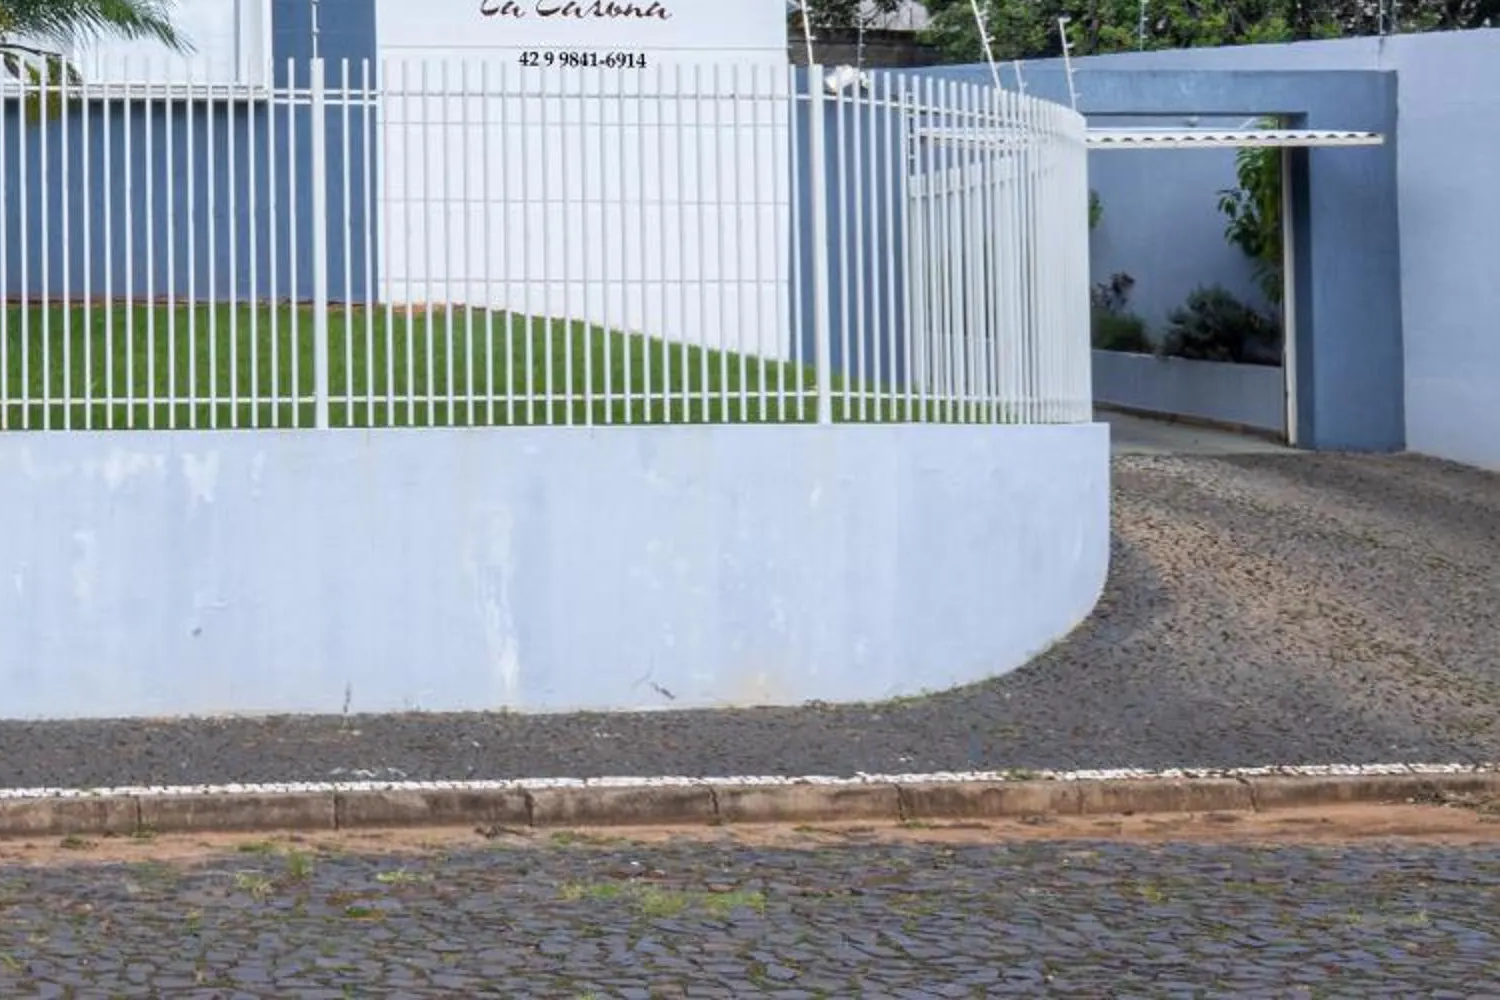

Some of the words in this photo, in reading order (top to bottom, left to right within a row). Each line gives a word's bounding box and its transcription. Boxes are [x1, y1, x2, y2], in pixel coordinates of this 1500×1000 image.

[518, 52, 540, 68] 42
[544, 52, 555, 68] 9
[559, 52, 647, 68] 9841-6914
